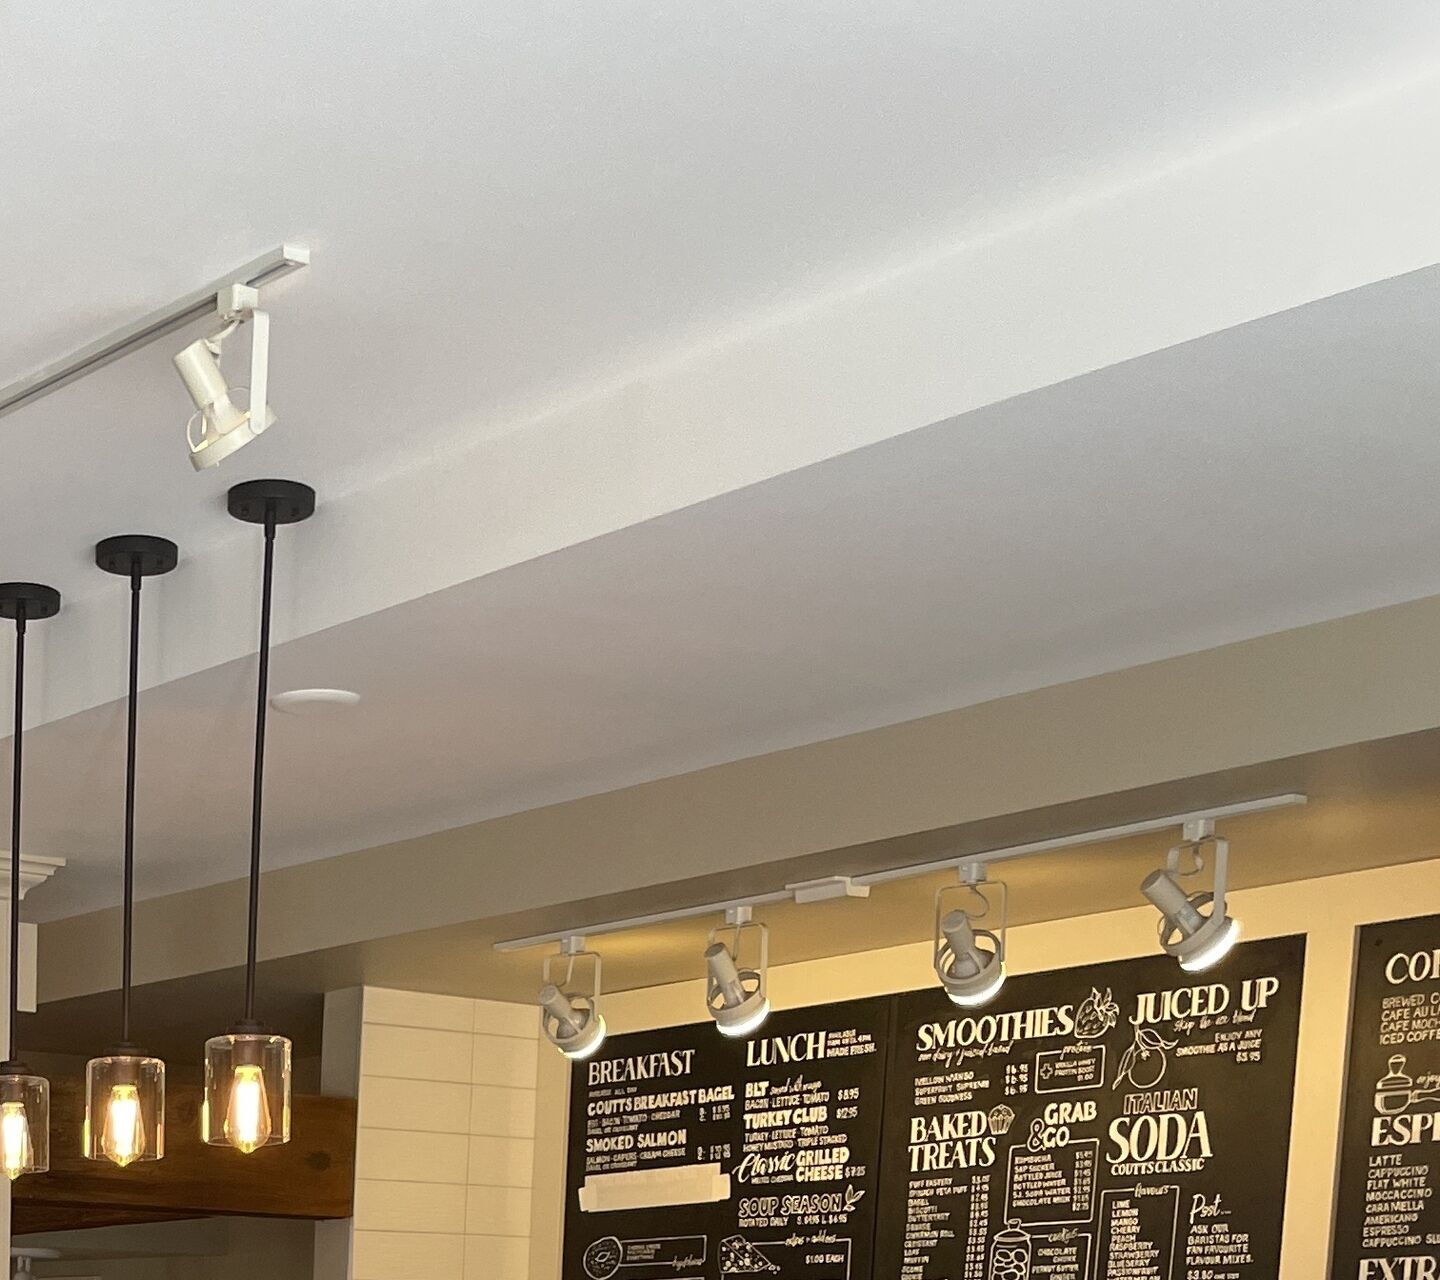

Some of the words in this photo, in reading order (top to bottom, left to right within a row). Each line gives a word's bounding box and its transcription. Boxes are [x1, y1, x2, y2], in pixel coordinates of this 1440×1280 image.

[1129, 983, 1231, 1025] JUICED
[1241, 976, 1280, 1012] UP
[1382, 994, 1425, 1009] BREWED
[1381, 1008, 1410, 1022] CAFE
[1413, 1006, 1429, 1018] AU
[916, 1004, 1074, 1052] SMOOTHIES
[1380, 1020, 1410, 1034] CAFE
[1214, 1031, 1243, 1043] ENJOY
[1244, 1029, 1263, 1039] ANY
[1379, 1032, 1405, 1046] ICED
[746, 1030, 827, 1067] LUNCH
[1175, 1044, 1216, 1057] SMOOTHIE
[1237, 1039, 1262, 1051] JUICE
[588, 1049, 695, 1086] BREAKFAST
[745, 1081, 770, 1098] BLT
[588, 1098, 632, 1116] COUTTS
[634, 1090, 696, 1111] BREAKFAST
[698, 1085, 735, 1103] BAGEL
[745, 1097, 769, 1111] BACON
[772, 1094, 800, 1108] LETTUCE
[1123, 1088, 1198, 1115] ITALIAN
[743, 1109, 793, 1129] TURKEY
[792, 1105, 828, 1125] CLUB
[1044, 1101, 1098, 1125] GRAB
[910, 1110, 988, 1144] BAKED
[586, 1135, 633, 1153] SMOKED
[637, 1129, 687, 1148] SALMON
[1027, 1118, 1047, 1152] &
[1043, 1126, 1070, 1148] GO
[1106, 1111, 1213, 1164] SODA
[908, 1137, 996, 1172] TREATS
[1368, 1154, 1402, 1168] LATTE
[732, 1151, 796, 1183] Classic
[796, 1146, 850, 1166] GRILLED
[1111, 1162, 1155, 1176] COUTTS
[1155, 1158, 1205, 1172] CLASSIC
[795, 1164, 844, 1183] CHEESE
[1368, 1165, 1429, 1180] CAPPUCCINO
[1367, 1179, 1390, 1191] FLAT
[1392, 1177, 1426, 1189] WHITE
[1365, 1188, 1433, 1202] MOCCACCINO
[738, 1196, 779, 1218] SOUP
[780, 1193, 843, 1215] SEASON
[1112, 1200, 1131, 1209] LIME
[1112, 1208, 1139, 1218] LEMON
[1363, 1213, 1419, 1226] AMERICANO
[1111, 1218, 1139, 1227] MANGO
[1190, 1225, 1209, 1234] ASK
[1211, 1224, 1229, 1233] OUR
[1111, 1226, 1140, 1235] CHERRY
[1362, 1225, 1410, 1237] ESPRESSO
[1111, 1235, 1136, 1243] PEACH
[1188, 1235, 1230, 1245] BARISTAS
[1231, 1234, 1250, 1243] FOR
[1362, 1236, 1421, 1248] CAPPUCCINO
[1037, 1247, 1077, 1257] CHOCOLATE
[1109, 1242, 1154, 1252] RASPBERRY
[1186, 1246, 1203, 1256] FAN
[1204, 1244, 1250, 1255] FAVOURITE
[1109, 1250, 1160, 1260] STRAWBERRY
[1186, 1255, 1221, 1266] FLAVOUR
[1108, 1259, 1150, 1269] BLUEBERRY
[1107, 1267, 1159, 1277] PASSIONFRUIT
